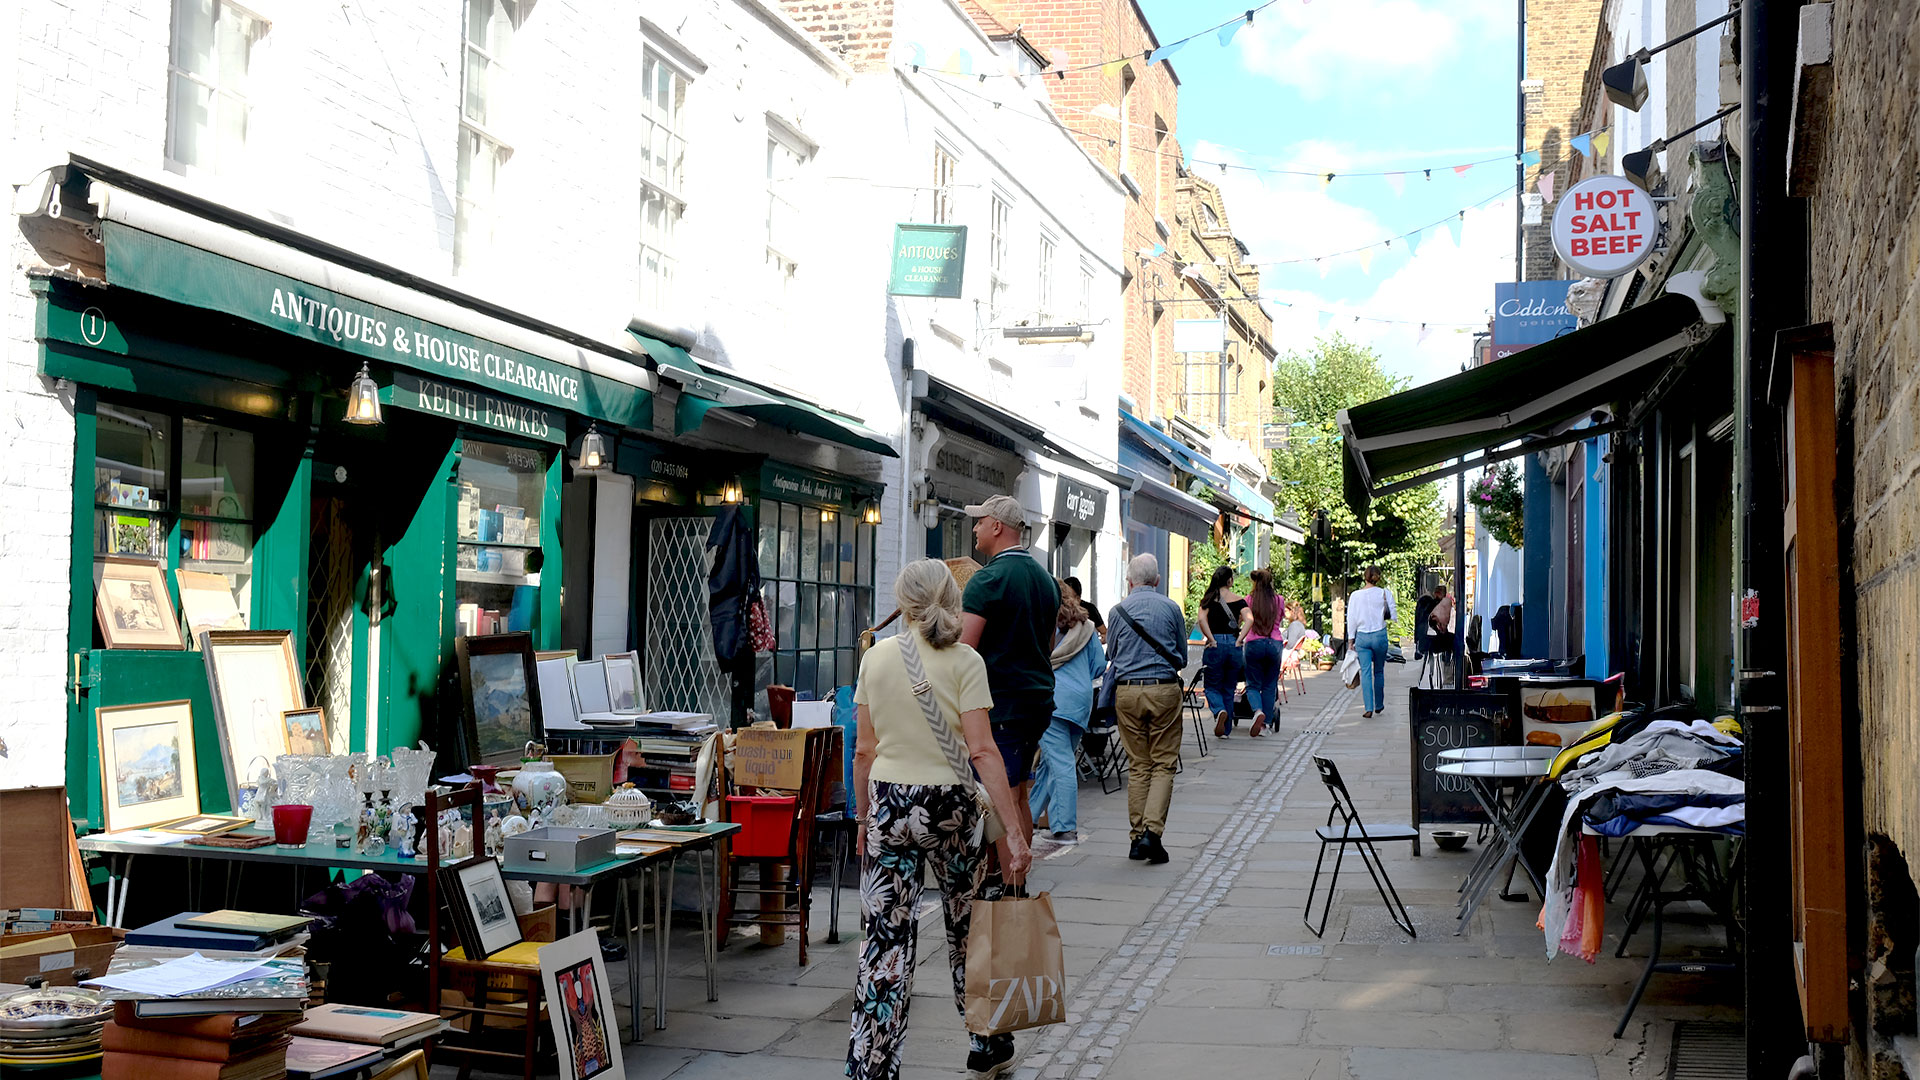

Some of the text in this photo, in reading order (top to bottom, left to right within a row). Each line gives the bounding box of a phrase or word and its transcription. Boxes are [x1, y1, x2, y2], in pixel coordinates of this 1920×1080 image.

[1574, 188, 1635, 211] HOT
[1570, 211, 1641, 234] SALT
[899, 245, 958, 261] ANTIQUES
[1570, 234, 1643, 257] BEEF
[904, 274, 949, 283] CLEARANCE
[918, 265, 943, 274] HOUSE
[1519, 318, 1568, 328] gelati
[270, 288, 579, 402] ANTIQUES & HOUSE CLEARANCE
[417, 379, 549, 438] KEITH FAWKES
[651, 459, 663, 473] 020
[936, 448, 973, 479] SUSHI
[1423, 725, 1479, 748] SOUP
[745, 759, 776, 776] liquid
[1435, 774, 1476, 793] NOOD
